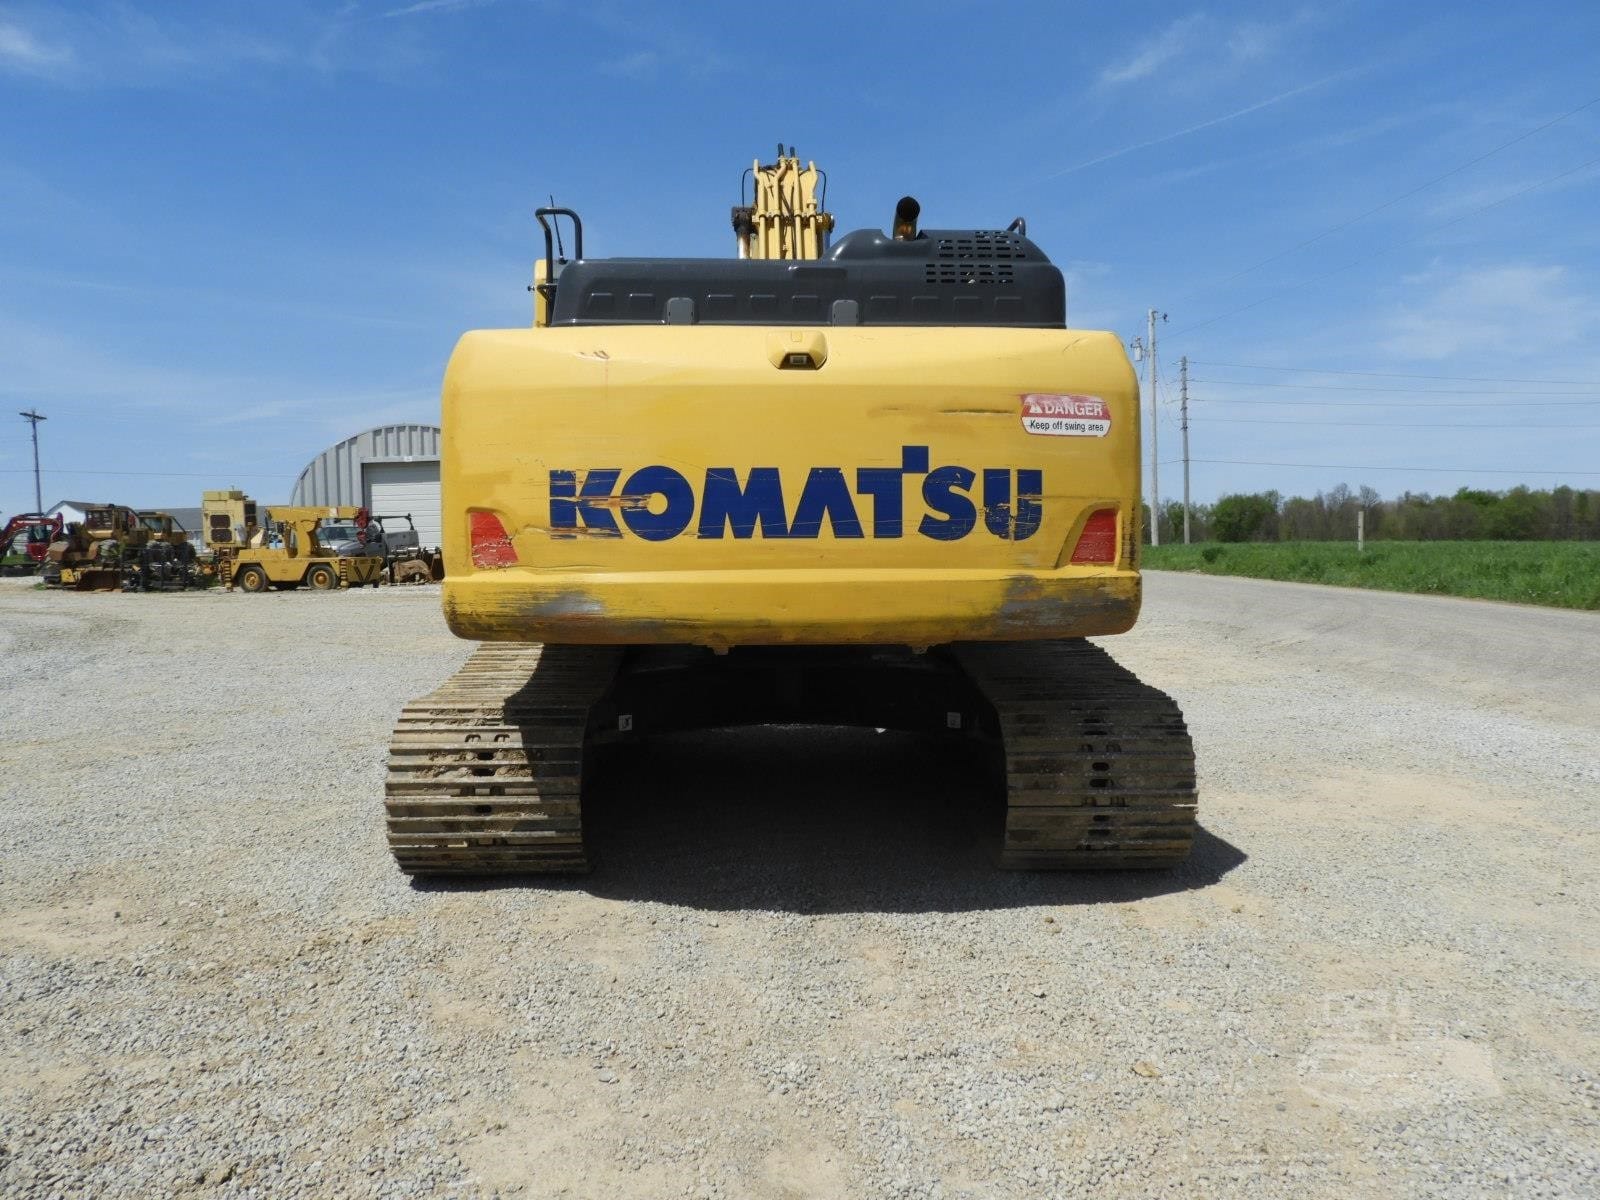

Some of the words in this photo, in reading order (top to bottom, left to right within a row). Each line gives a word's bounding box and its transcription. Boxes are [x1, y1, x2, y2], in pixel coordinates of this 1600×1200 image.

[1044, 400, 1103, 416] DANGER
[1030, 420, 1050, 431] Keep
[1052, 421, 1062, 429] off
[1065, 421, 1085, 432] swing
[1088, 423, 1104, 431] area
[549, 446, 1043, 541] KOMATSU
